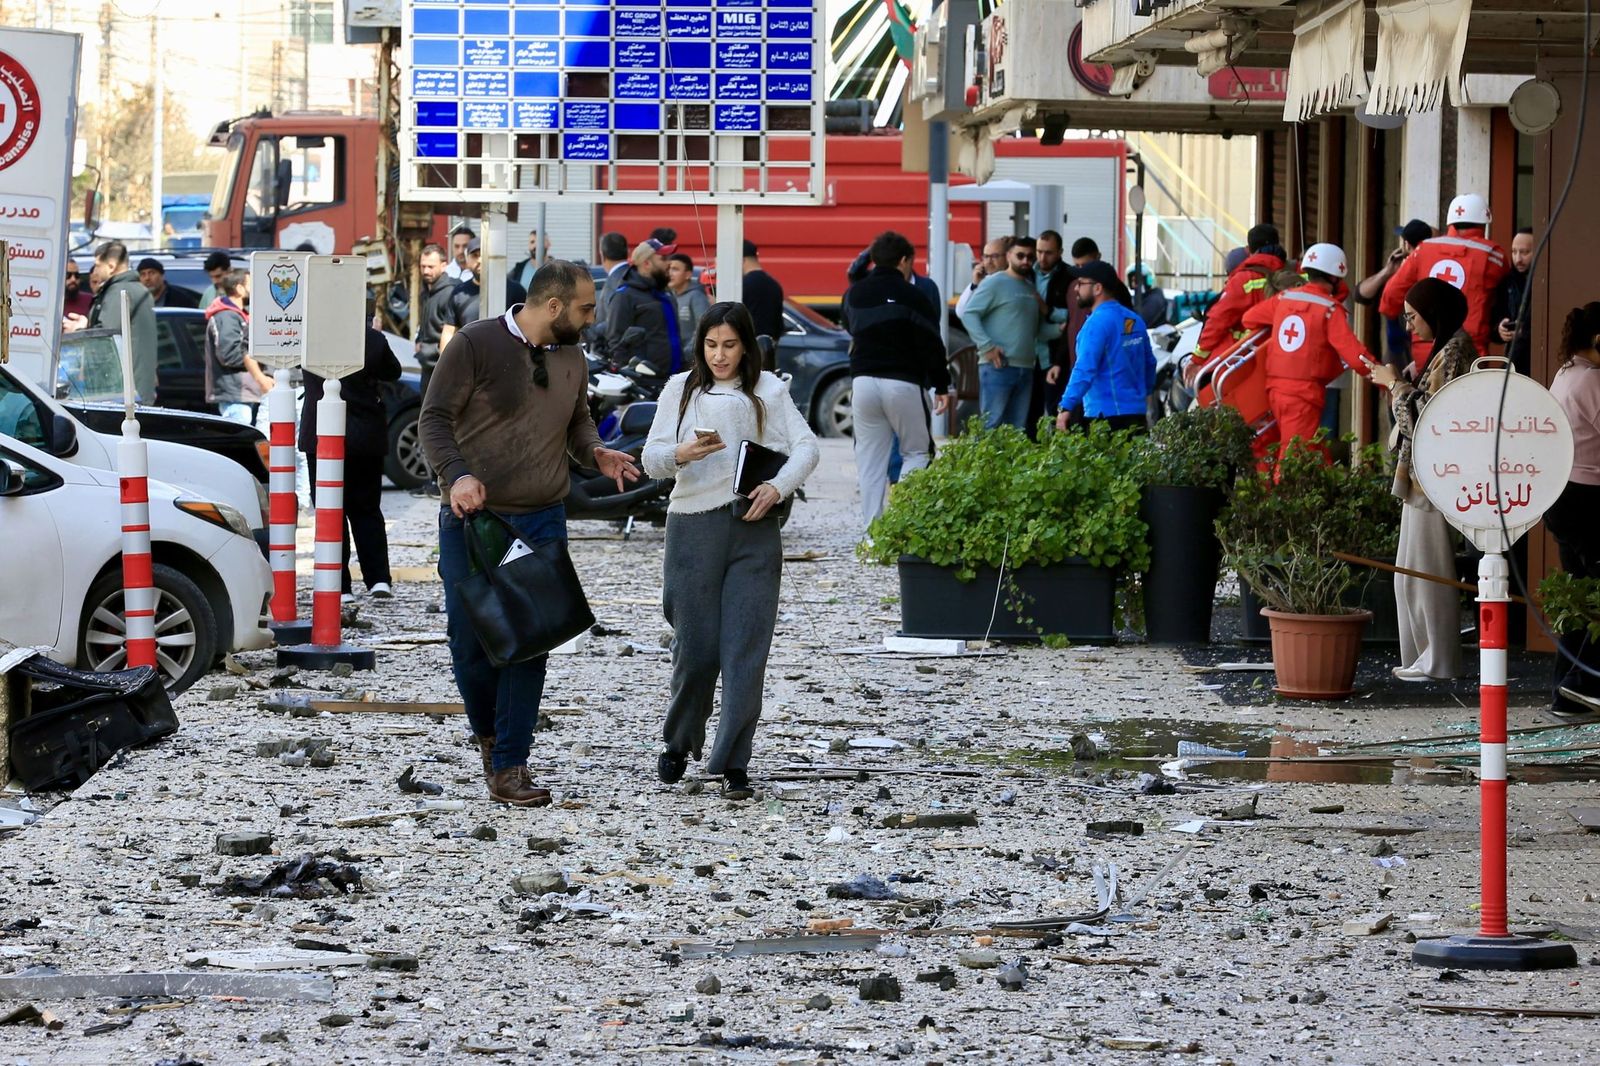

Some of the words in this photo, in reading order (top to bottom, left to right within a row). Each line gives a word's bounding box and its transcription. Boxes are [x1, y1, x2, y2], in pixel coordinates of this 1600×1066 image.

[634, 12, 658, 20] GROUP
[723, 13, 756, 24] MIG
[0, 207, 40, 218] مدر
[9, 243, 45, 260] مستو
[16, 286, 41, 301] طب
[265, 314, 282, 325] صيدا
[10, 322, 41, 338] قسم
[1455, 482, 1532, 515] للزبائن
